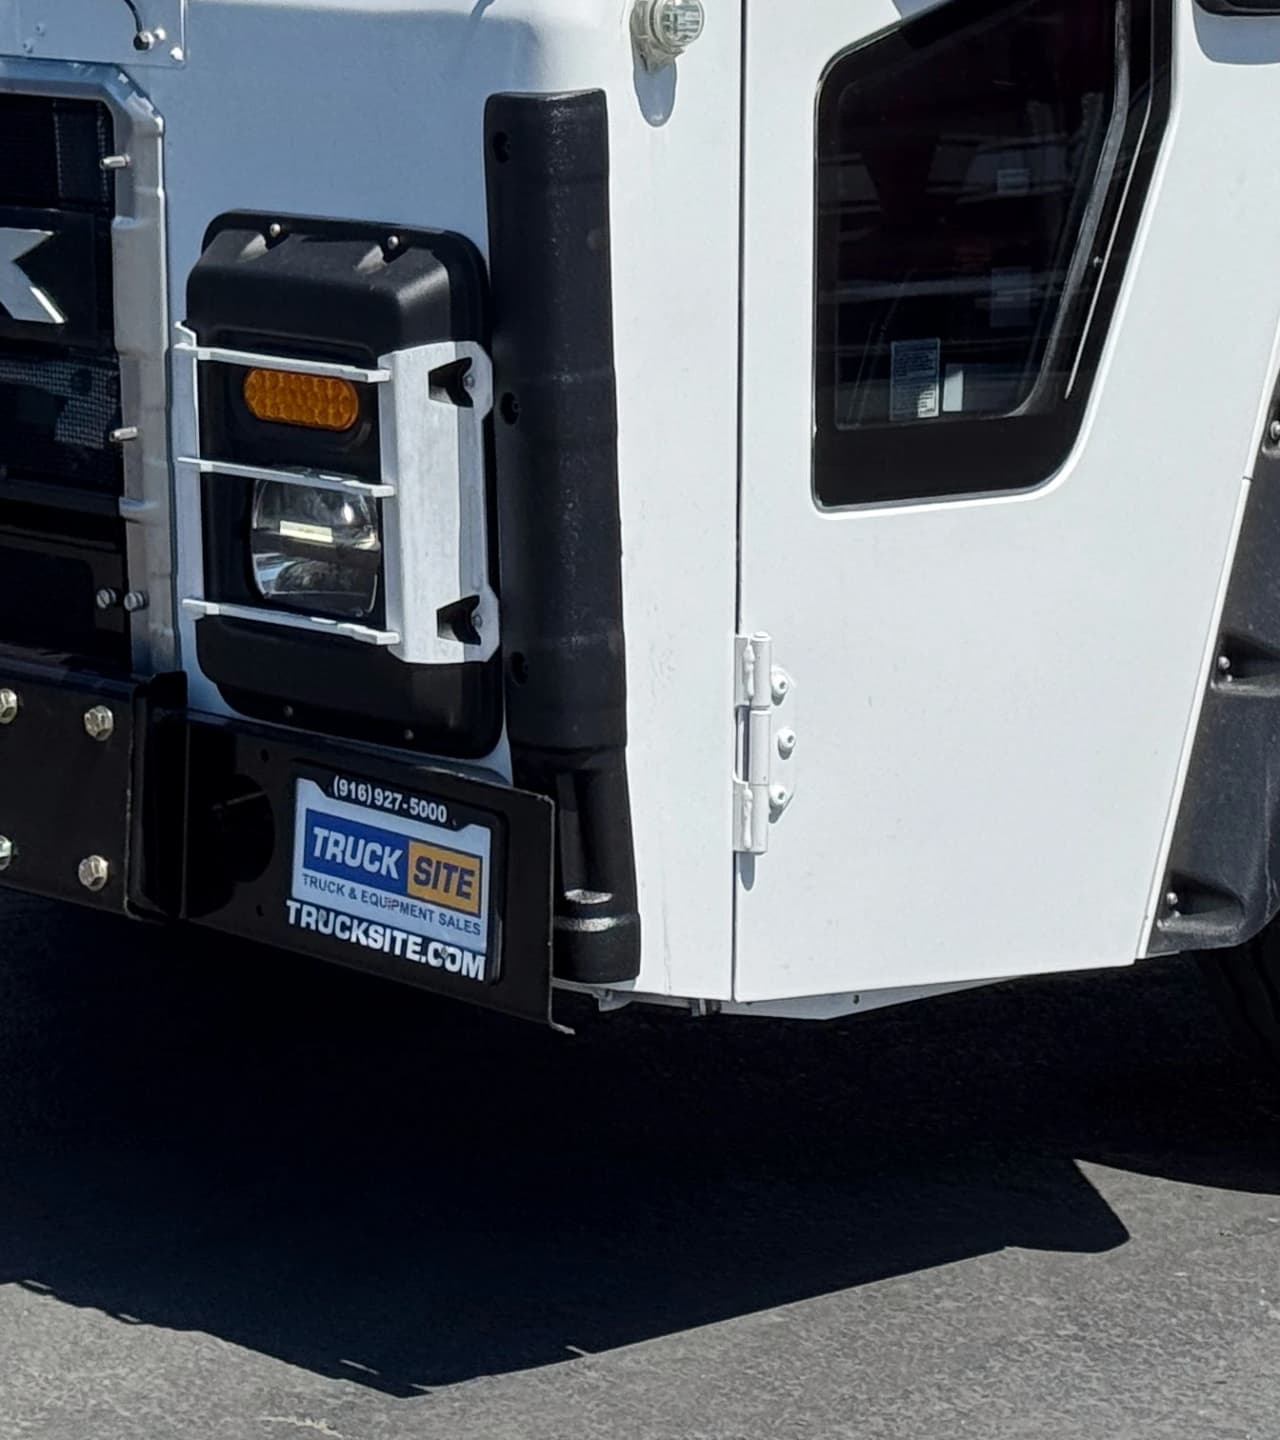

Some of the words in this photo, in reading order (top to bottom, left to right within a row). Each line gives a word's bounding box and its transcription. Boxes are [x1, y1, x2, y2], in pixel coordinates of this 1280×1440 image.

[313, 826, 404, 880] TRUCK
[413, 855, 476, 900] SITE
[286, 899, 486, 981] TRUCKSITE.COM
[302, 873, 346, 898] TRUCK
[348, 887, 357, 901] &
[361, 889, 435, 923] EQUIPMENT
[438, 913, 481, 936] SALES
